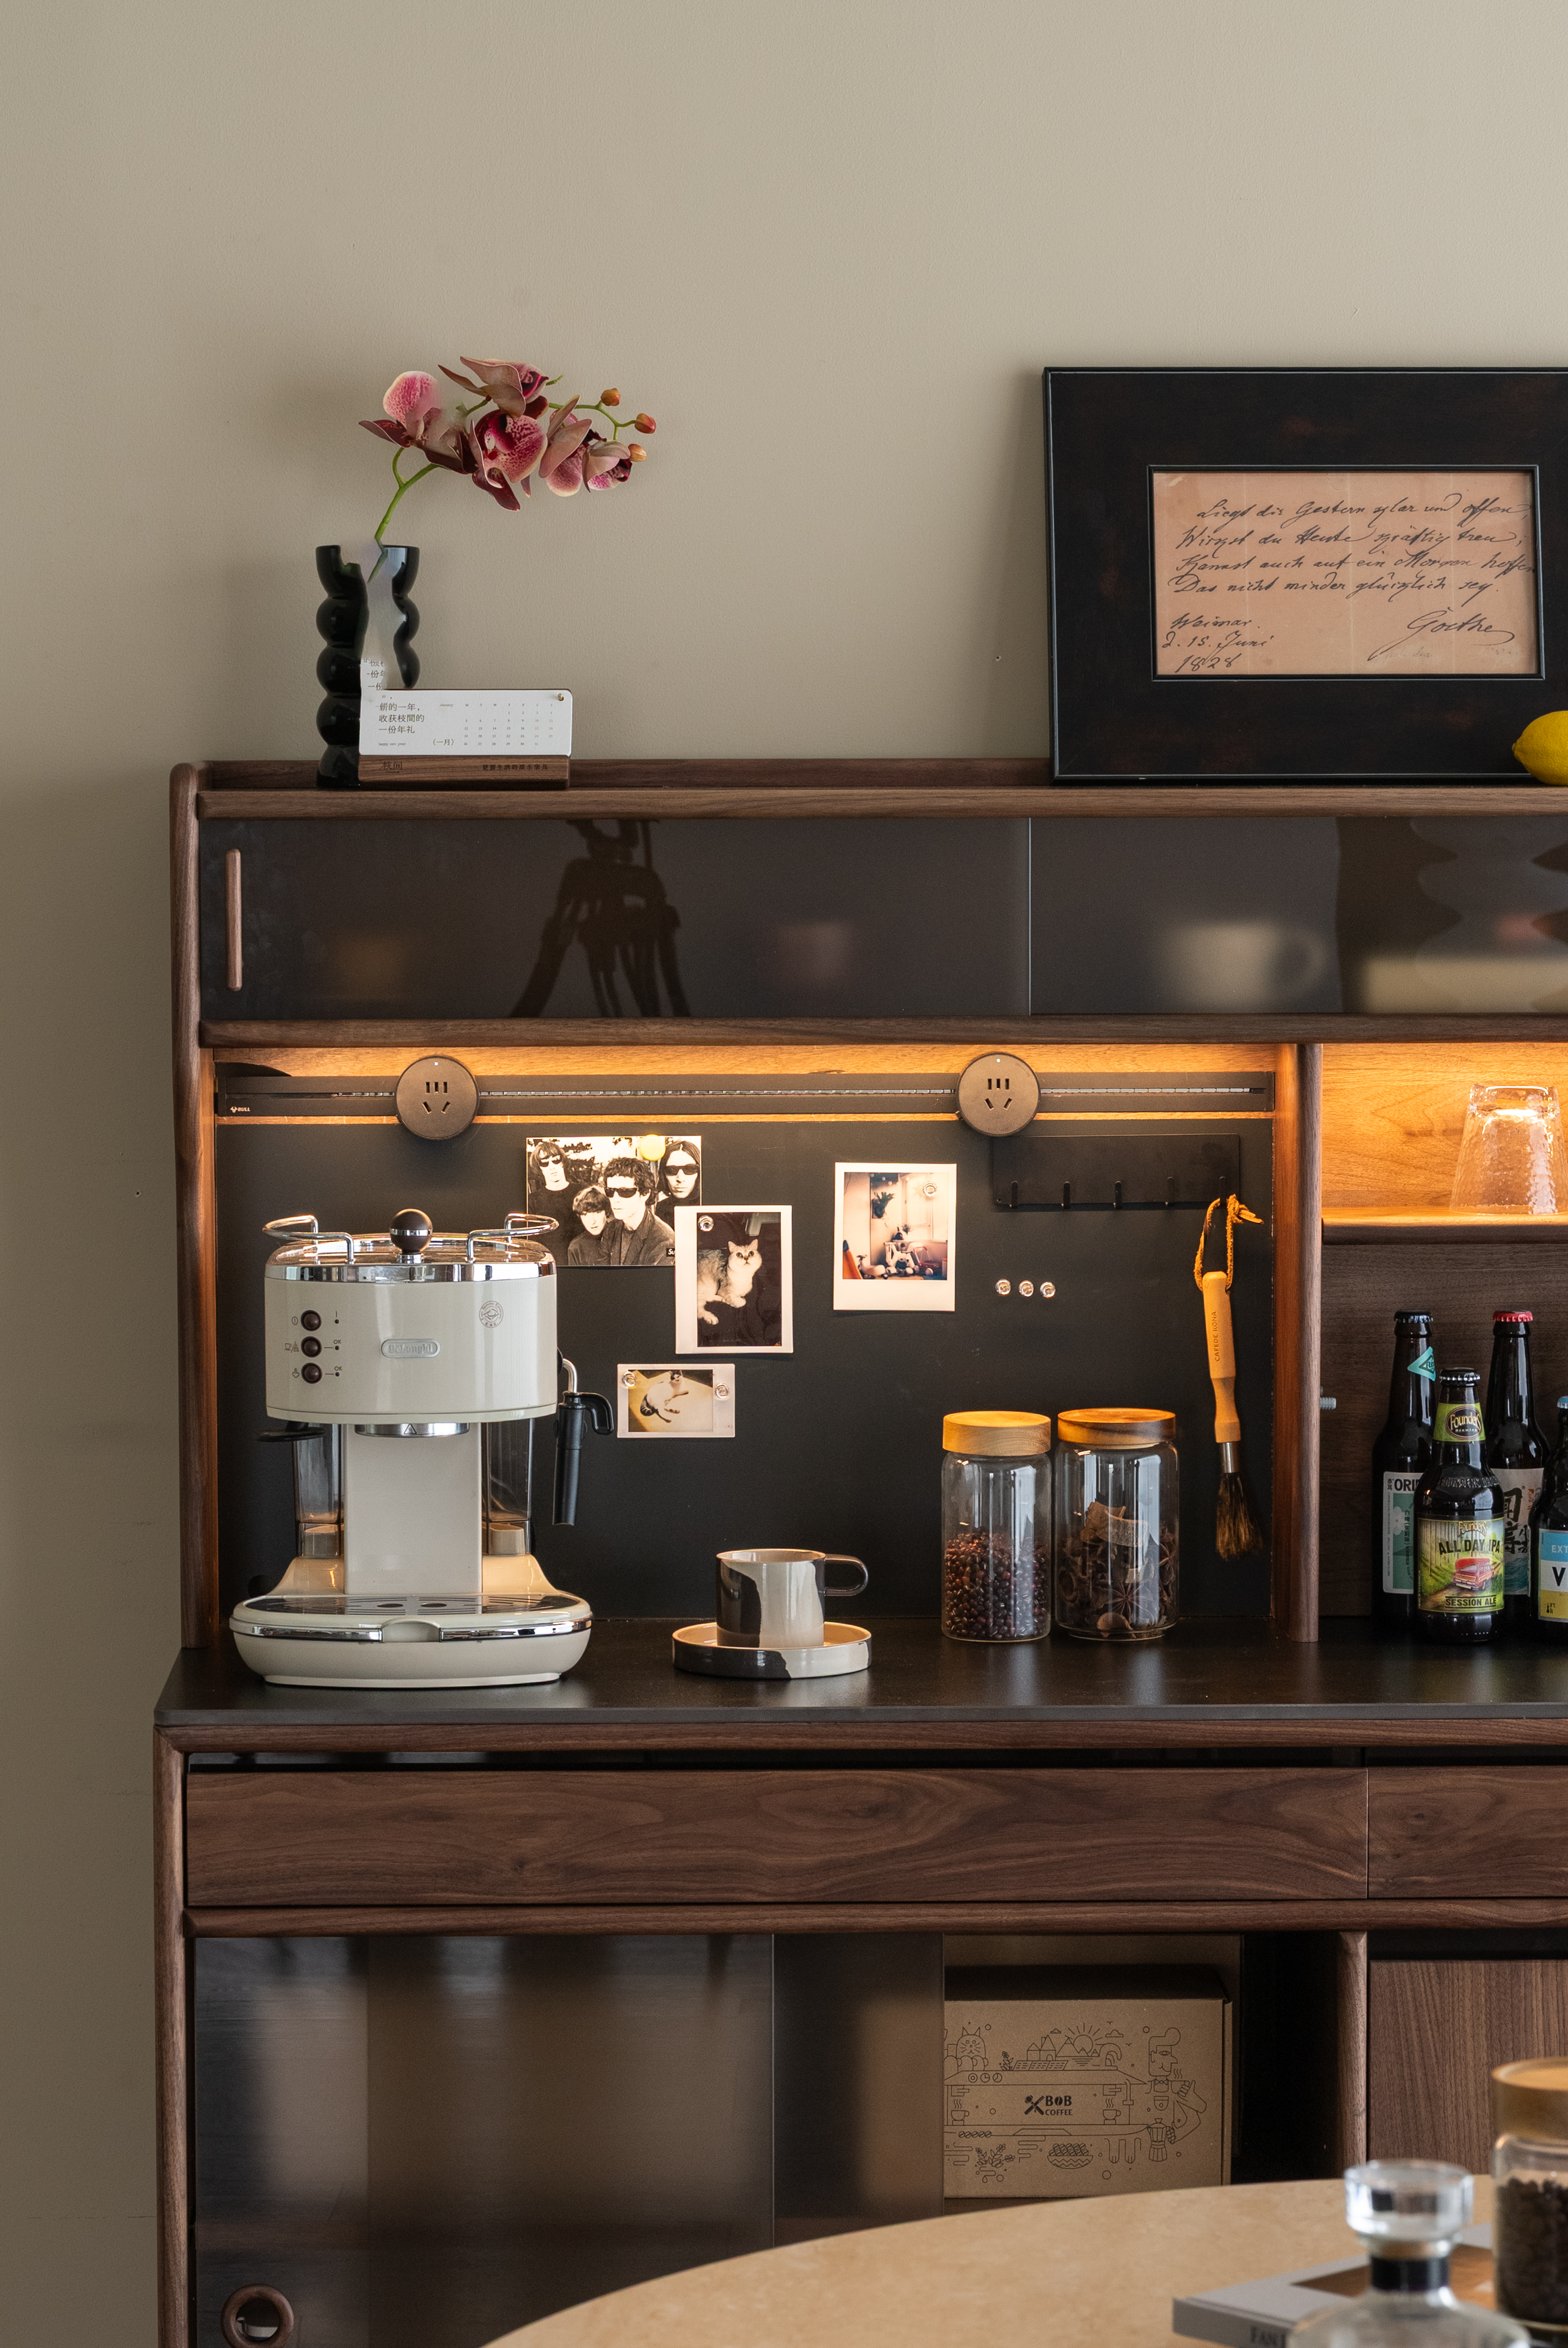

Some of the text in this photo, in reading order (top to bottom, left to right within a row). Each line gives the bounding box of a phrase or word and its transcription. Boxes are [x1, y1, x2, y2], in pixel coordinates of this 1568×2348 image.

[378, 725, 416, 734] 一份年礼
[1438, 1539, 1461, 1556] ALL
[1464, 1539, 1485, 1552] DAY
[1488, 1539, 1500, 1553] IPA
[1445, 1596, 1497, 1606] SESSION ALE
[1045, 2095, 1072, 2107] BOB
